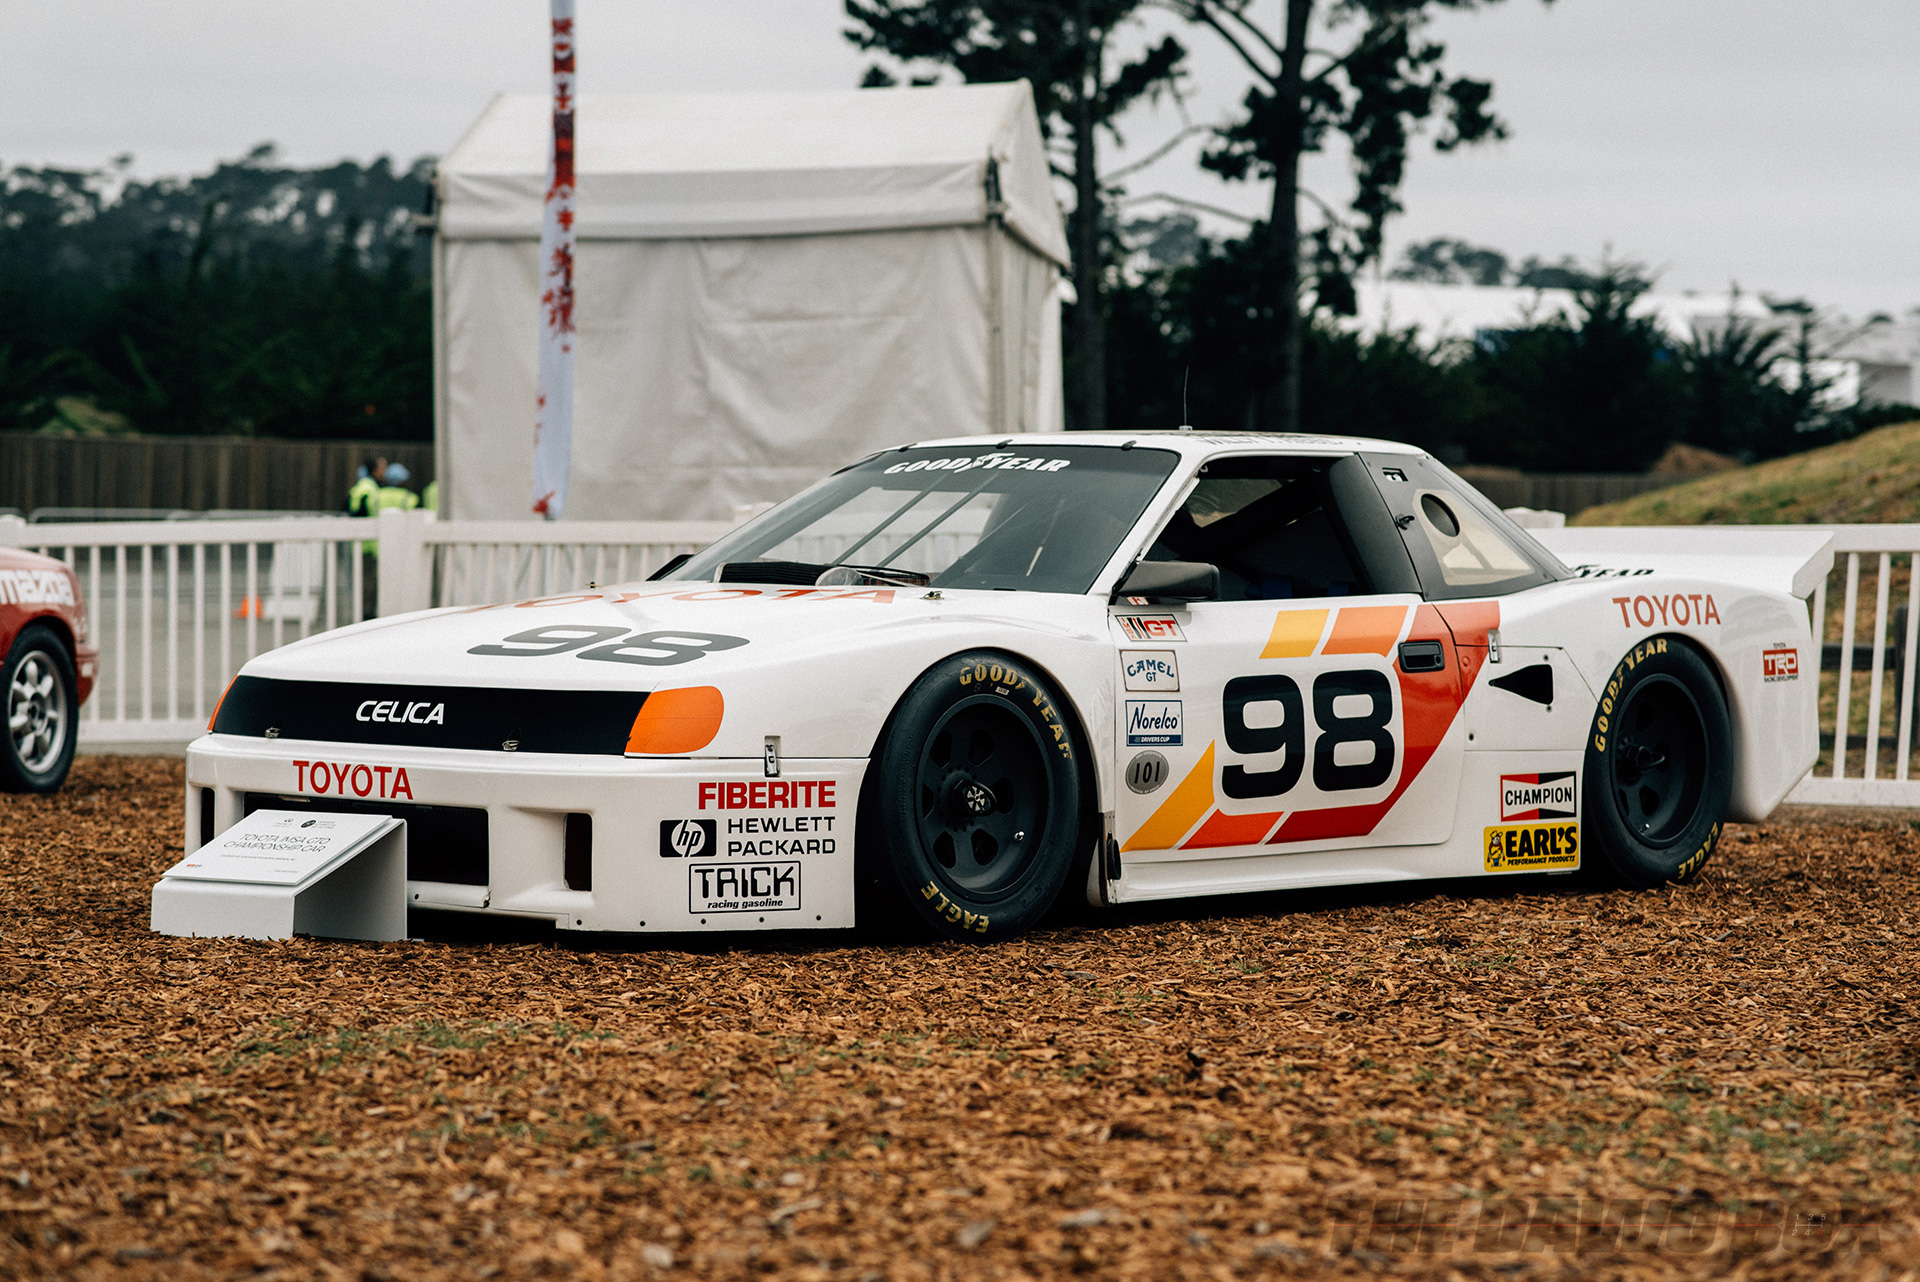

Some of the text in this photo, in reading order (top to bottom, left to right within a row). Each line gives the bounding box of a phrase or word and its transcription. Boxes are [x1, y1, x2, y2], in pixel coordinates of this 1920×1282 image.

[1612, 594, 1721, 628] TOYOTA
[1143, 620, 1177, 636] GT
[466, 625, 750, 666] 98
[1127, 659, 1174, 678] CAMEL
[1764, 653, 1797, 675] TRD
[1146, 671, 1157, 682] GT
[356, 700, 445, 725] CELICA
[1129, 703, 1178, 734] Norelco
[1221, 669, 1396, 800] 98
[293, 760, 414, 800] TOYOTA
[1134, 761, 1160, 784] 101
[698, 781, 836, 810] FIBERITE
[1504, 786, 1572, 807] CHAMPION
[728, 816, 835, 833] HEWLETT
[240, 834, 279, 842] TOYOTA
[676, 819, 702, 857] hp
[728, 839, 836, 856] PACKARD
[1505, 826, 1577, 857] EARL'S
[1507, 855, 1576, 866] PERFORMANCE PRODUCTS
[694, 866, 794, 898] TRICK
[707, 898, 783, 909] racing gasoline
[920, 880, 990, 933] EAGLE
